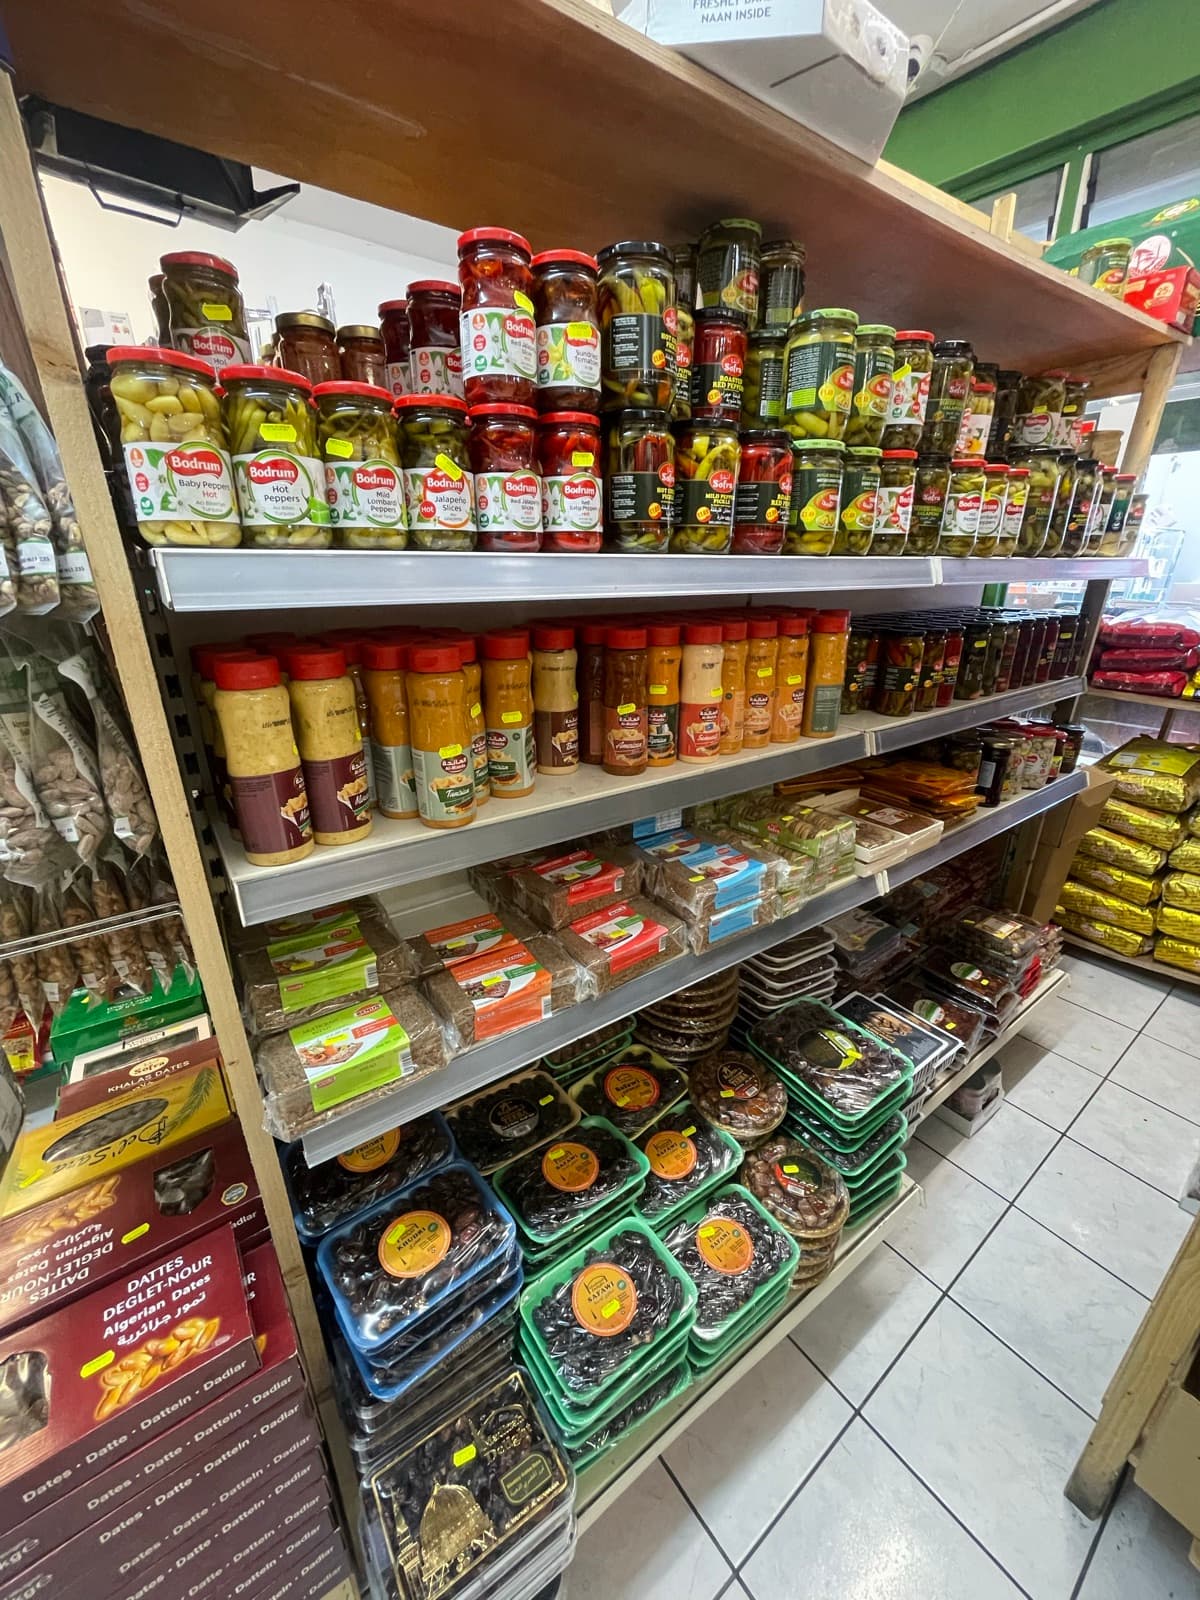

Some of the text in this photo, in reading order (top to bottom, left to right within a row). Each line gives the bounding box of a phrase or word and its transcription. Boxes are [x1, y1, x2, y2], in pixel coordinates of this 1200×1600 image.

[701, 6, 772, 24] NAAN INSIDE
[506, 320, 535, 338] Bodrum
[193, 339, 233, 354] Bodrum
[171, 456, 220, 472] Bodrum
[250, 466, 295, 479] Bodrum
[179, 479, 230, 491] Baby Peppers
[272, 485, 288, 493] Hot
[356, 474, 395, 486] Bodrum
[427, 478, 463, 488] Bodrum
[505, 481, 537, 493] Bodrum
[712, 479, 733, 488] Sofra
[202, 490, 218, 498] Hot
[263, 494, 300, 504] Peppers
[376, 491, 390, 499] Mild
[564, 485, 595, 495] Bodrum
[434, 495, 467, 504] Jalapeño
[370, 505, 397, 514] Peppers
[421, 505, 434, 513] Hot
[108, 1060, 190, 1093] KHALAS DATES
[133, 1060, 164, 1076] Sofra
[710, 1231, 731, 1250] SAFAWI
[7, 1228, 114, 1283] Algerian Dates
[1, 1242, 114, 1302] DEGLET-NOUR
[127, 1256, 184, 1293] DATTES
[29, 1267, 90, 1305] DATTES
[103, 1255, 213, 1321] DEGLET-NOUR
[586, 1281, 615, 1304] SAFAWI
[103, 1298, 166, 1339] Algerian
[171, 1274, 211, 1300] Dates
[117, 1292, 207, 1346] تمور جزائرية
[22, 1360, 248, 1504] Dates Datte Datteln Dadlar
[87, 1374, 293, 1511] Dates Datte Datteln Dadlar
[99, 1403, 300, 1544] Dates Datte Datteln Dadlar
[119, 1433, 312, 1574] Dates Datte Datteln Dadlar
[175, 1538, 212, 1569] Datte
[221, 1499, 266, 1534] Datteln
[274, 1464, 313, 1495] Dadlar
[188, 1496, 320, 1597] Datte Datteln Dadlar
[235, 1524, 321, 1595] Datteln Dadlar
[301, 1545, 335, 1577] Dadlar
[308, 1564, 343, 1596] Dadlar
